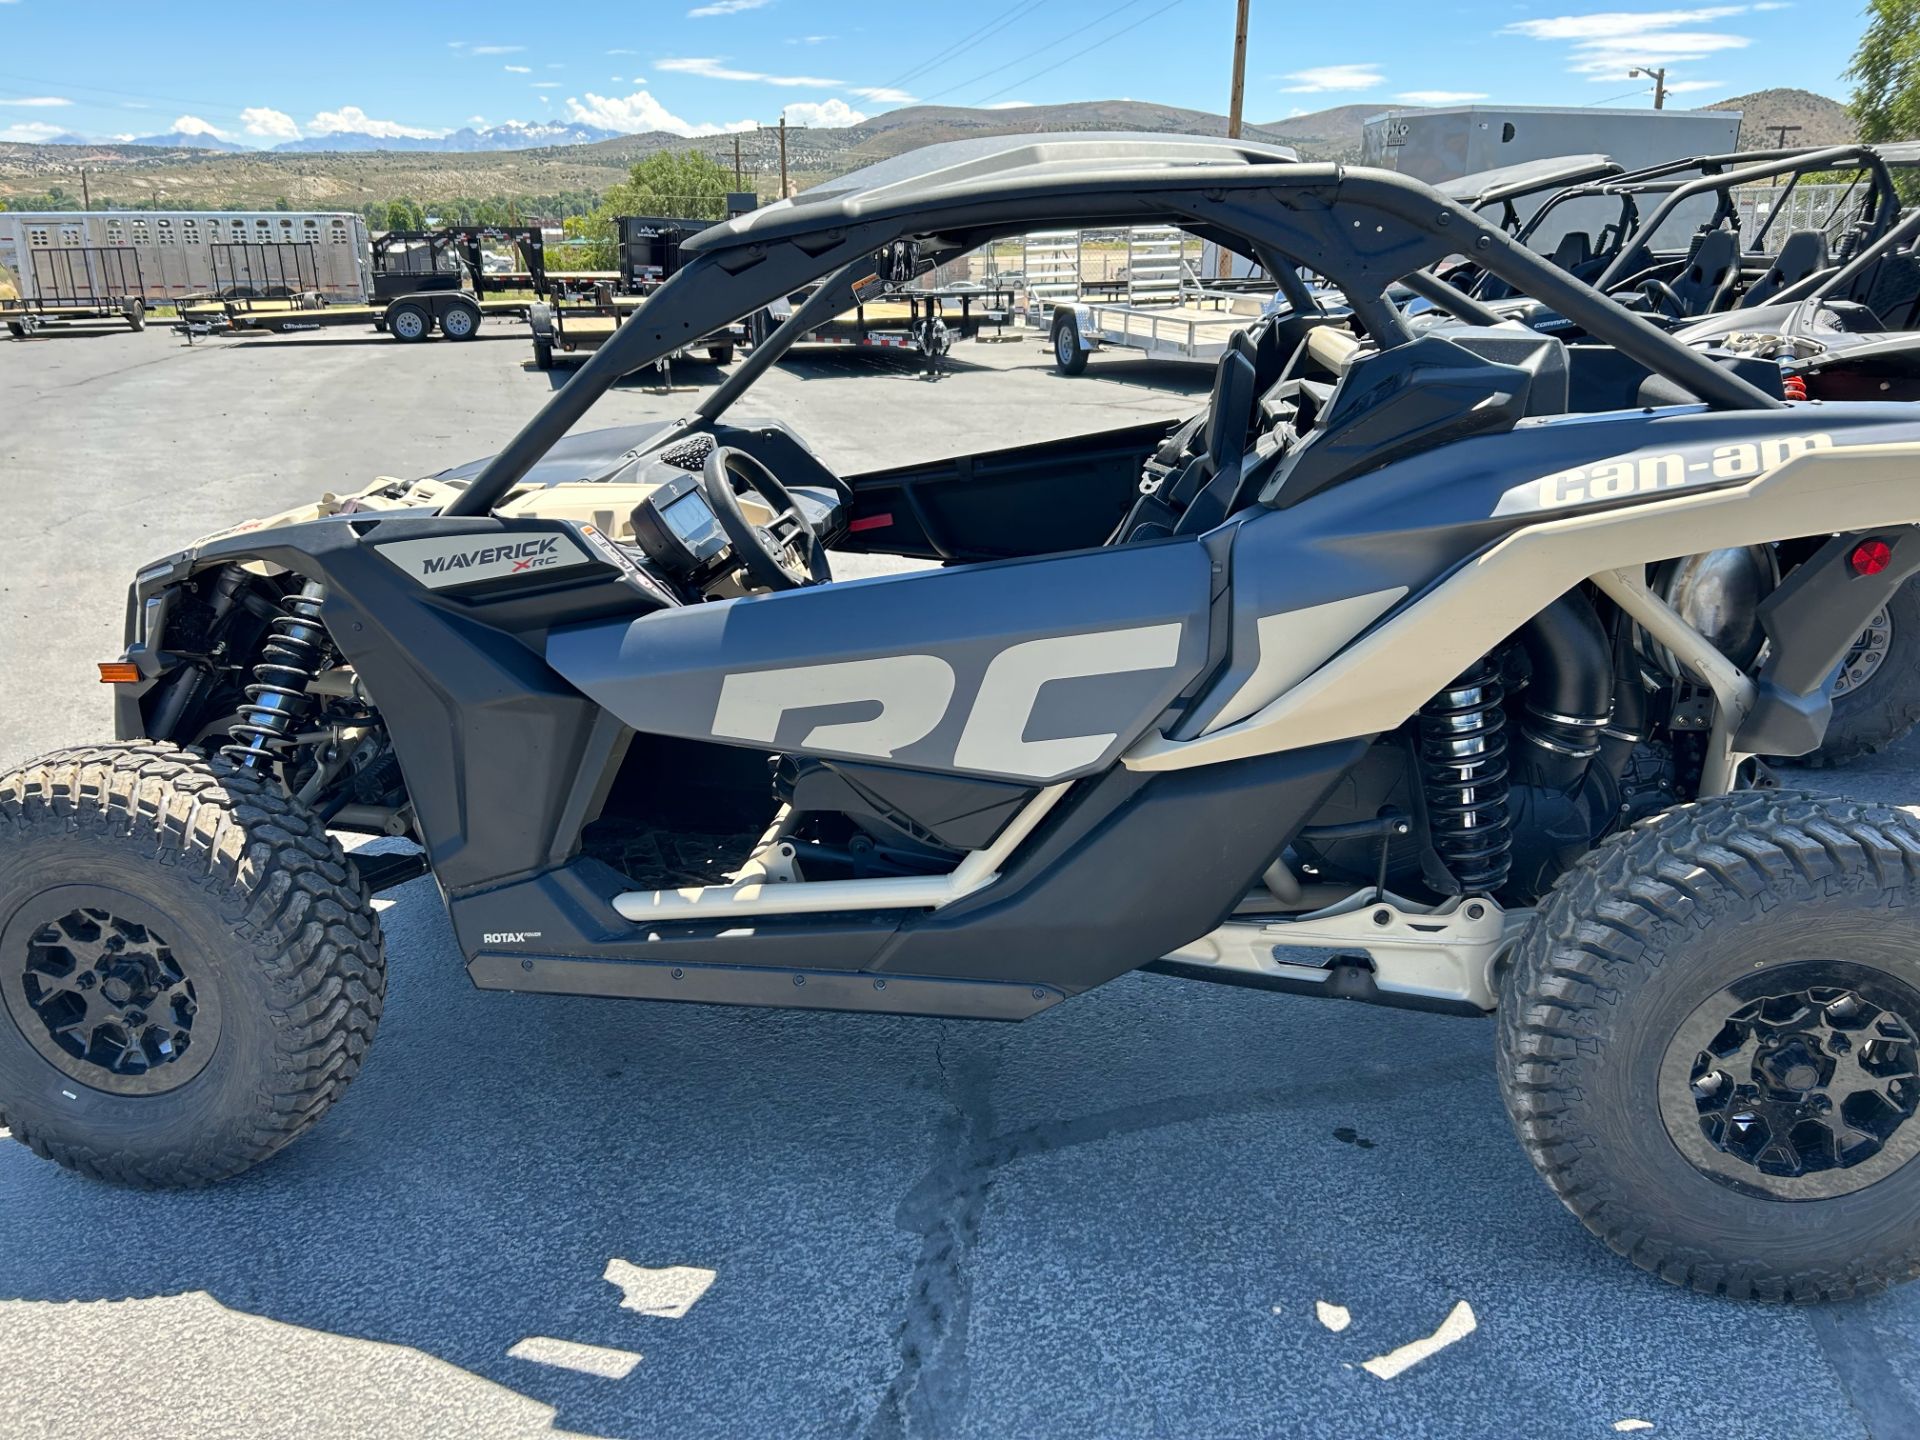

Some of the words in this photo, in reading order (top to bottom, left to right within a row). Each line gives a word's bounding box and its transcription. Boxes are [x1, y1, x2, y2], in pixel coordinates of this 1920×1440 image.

[1539, 433, 1833, 508] can-am
[422, 536, 559, 575] MAVERICK
[711, 622, 1183, 778] RC
[483, 932, 526, 944] ROTAX
